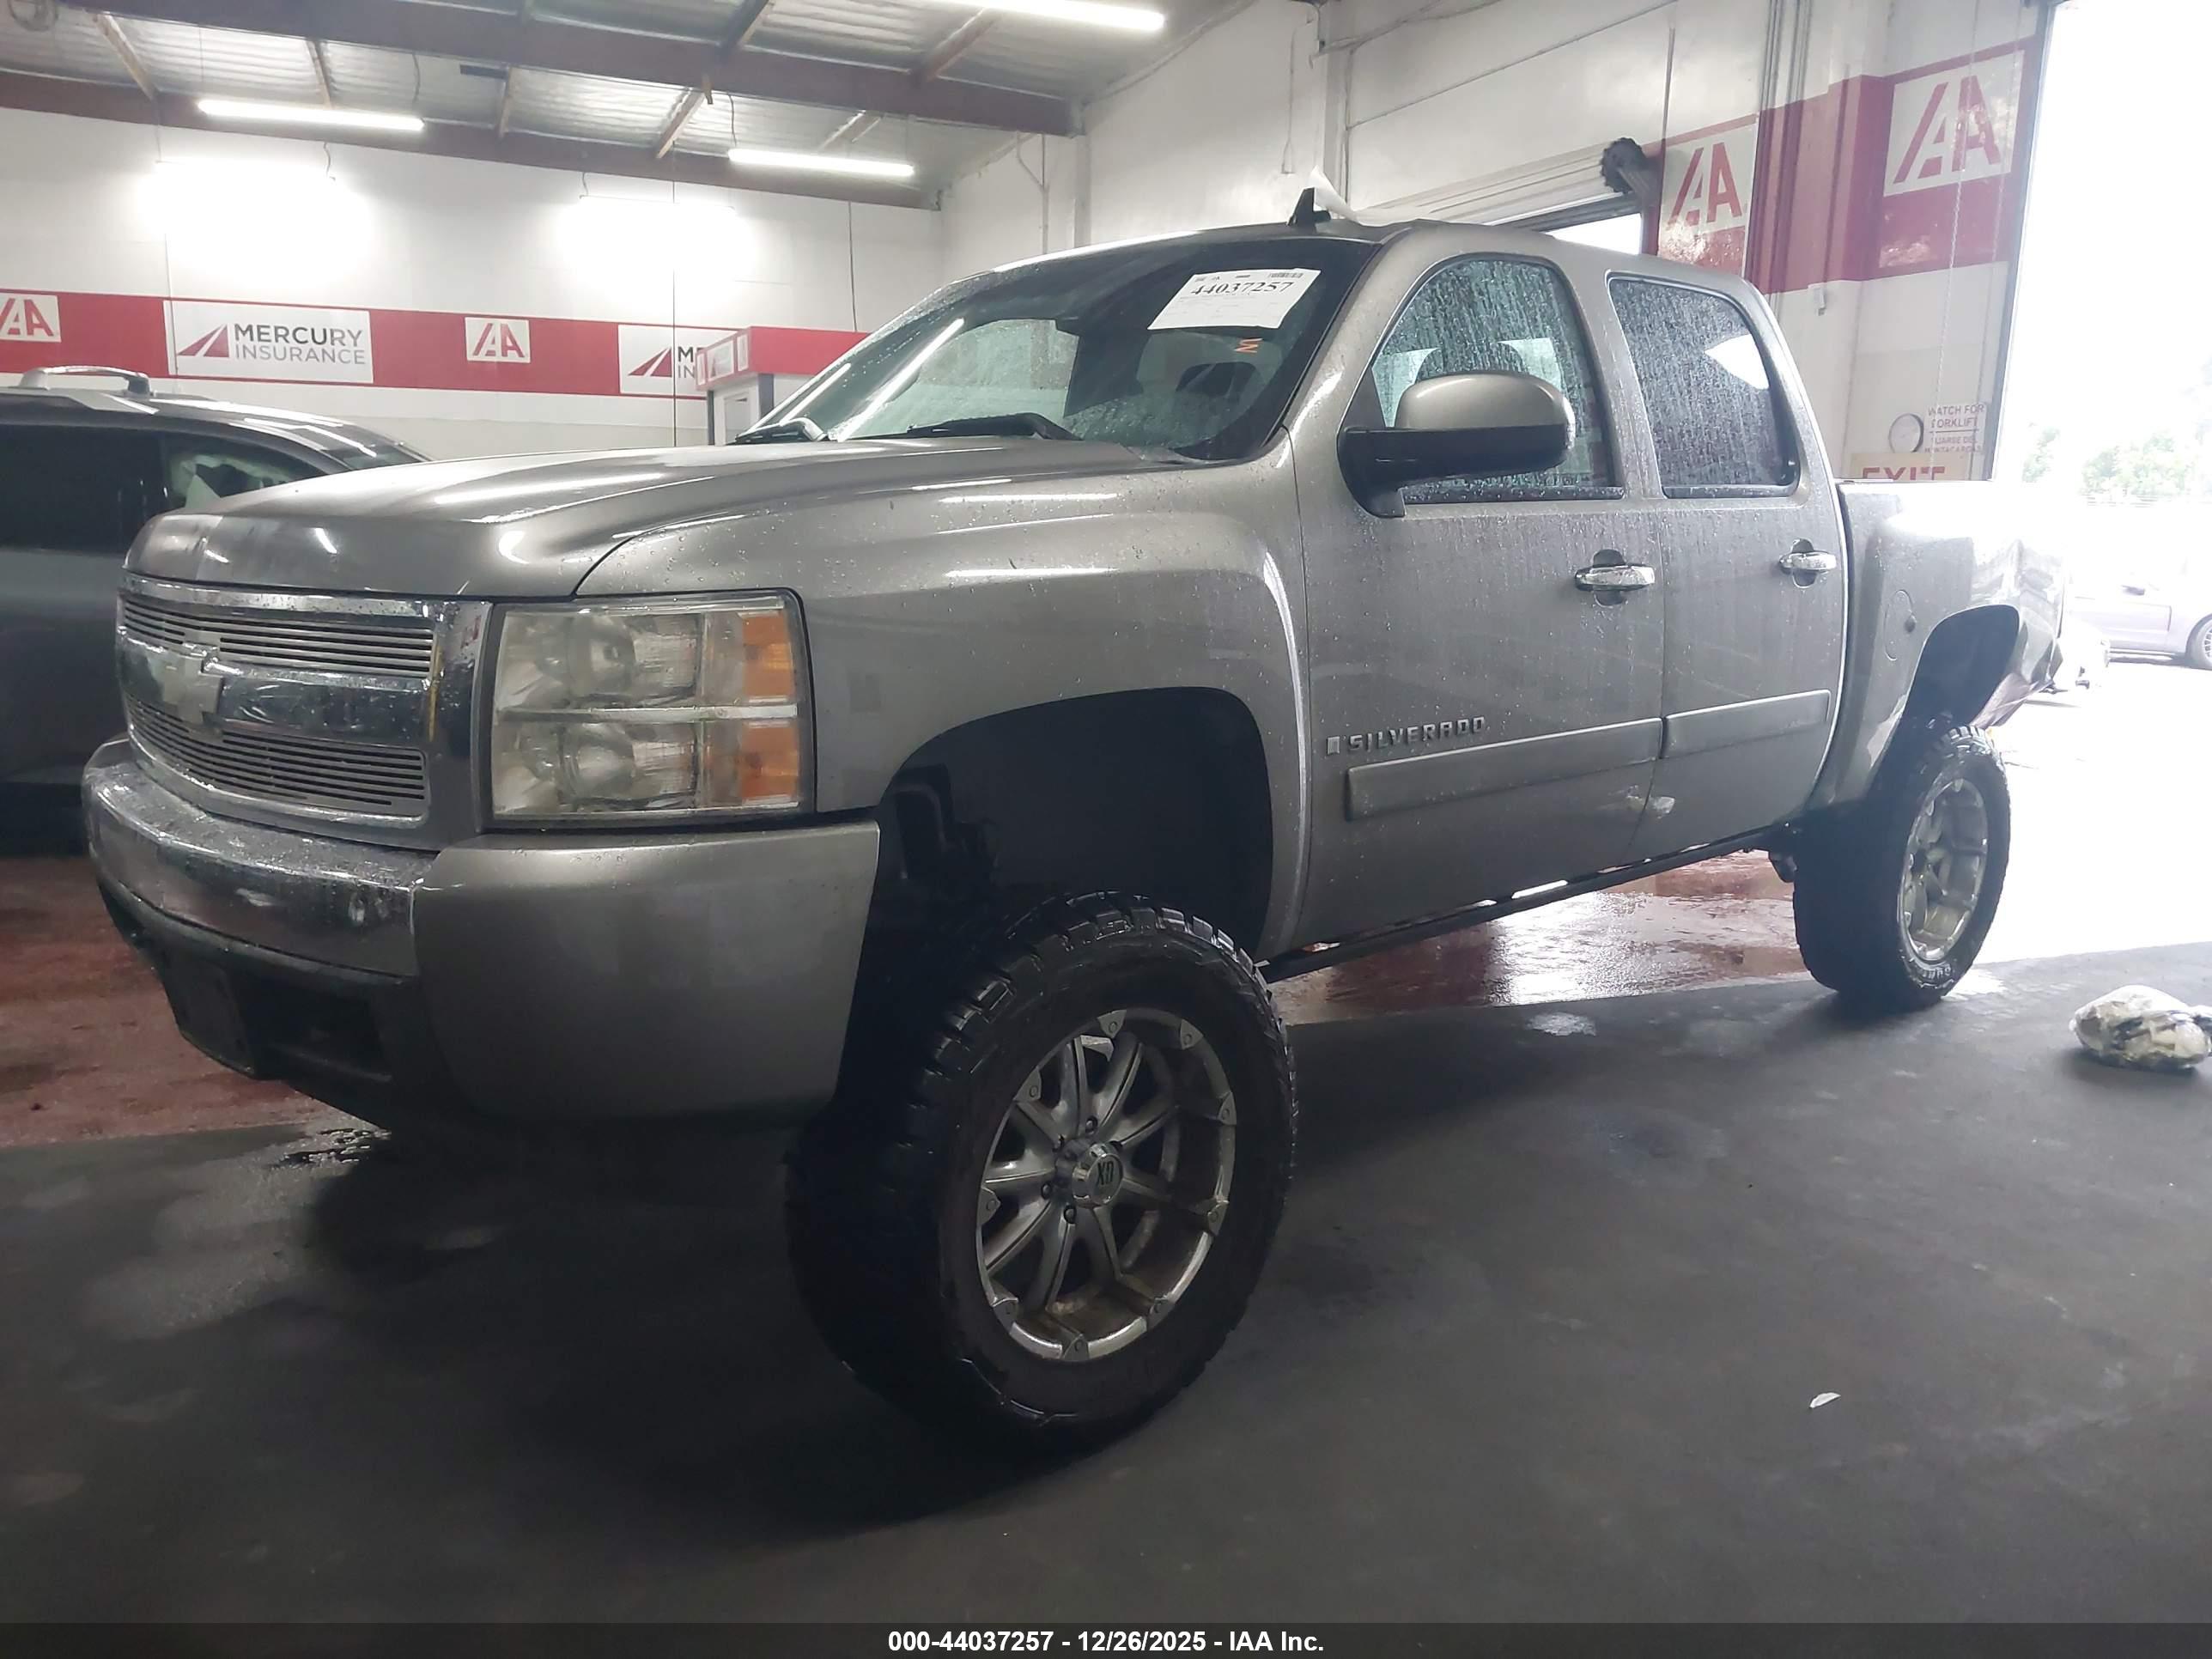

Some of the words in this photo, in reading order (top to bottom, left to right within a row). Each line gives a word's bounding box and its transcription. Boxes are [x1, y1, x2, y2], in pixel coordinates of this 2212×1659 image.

[1191, 281, 1294, 295] 44037257
[234, 323, 362, 347] MERCURY
[235, 343, 366, 365] INSURANCE
[1928, 405, 1961, 416] WATCH
[1964, 404, 1984, 414] FOR
[1349, 716, 1486, 752] SILVERADO
